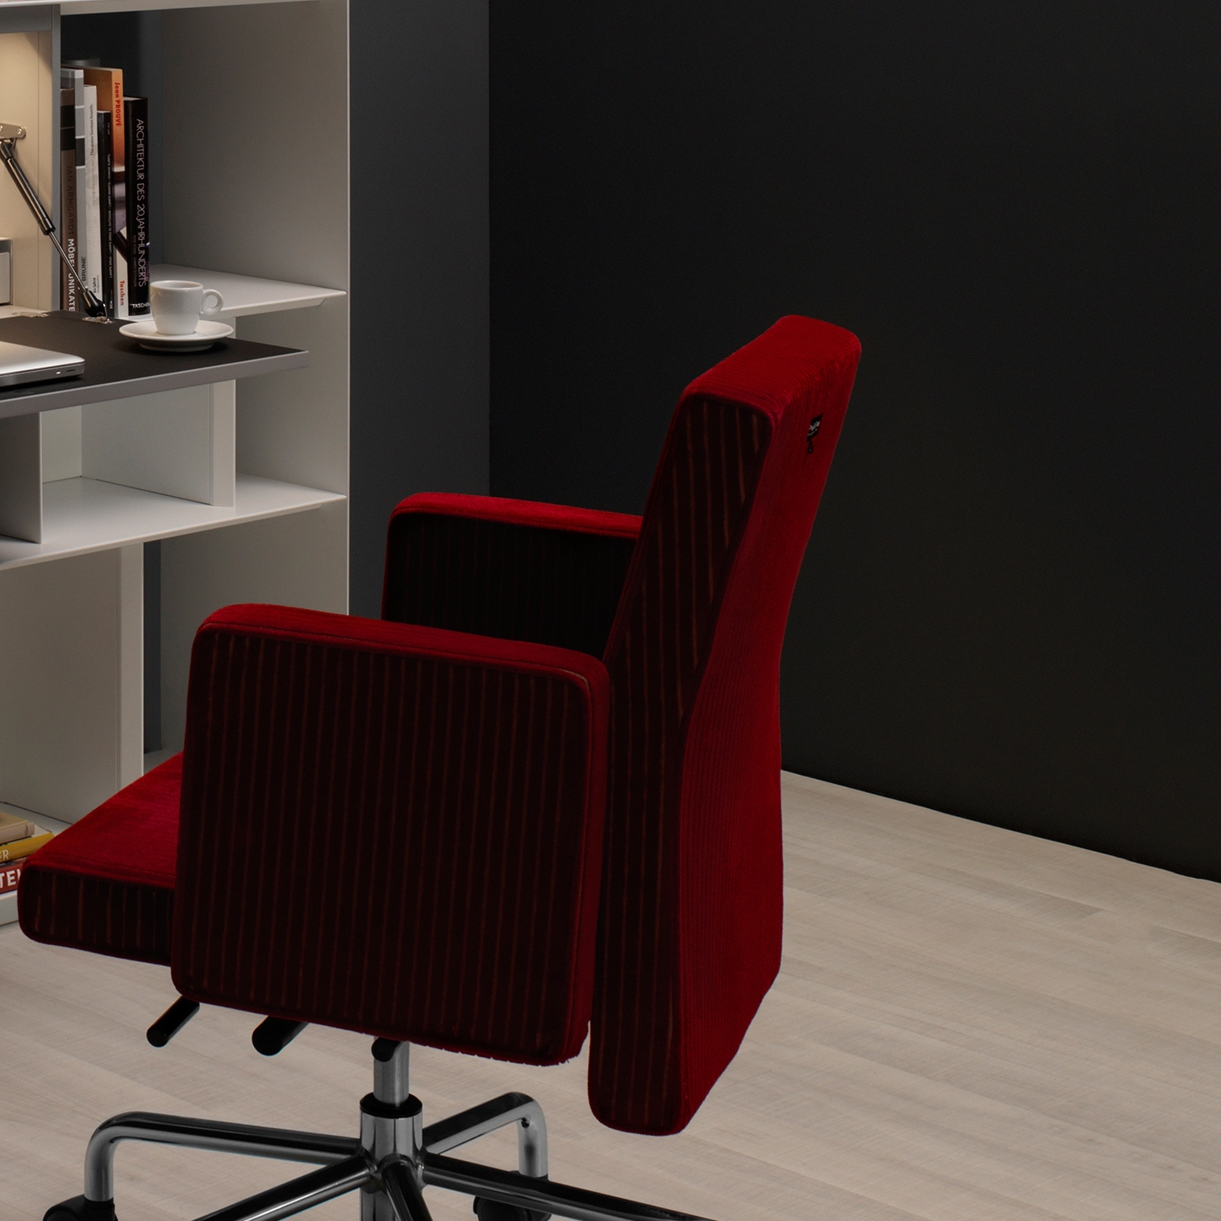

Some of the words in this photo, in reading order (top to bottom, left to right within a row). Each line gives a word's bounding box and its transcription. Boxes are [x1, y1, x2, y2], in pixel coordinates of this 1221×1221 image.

[135, 119, 145, 181] ARCHITEKTUR
[67, 186, 75, 235] ARMGARDT
[135, 183, 145, 201] DES
